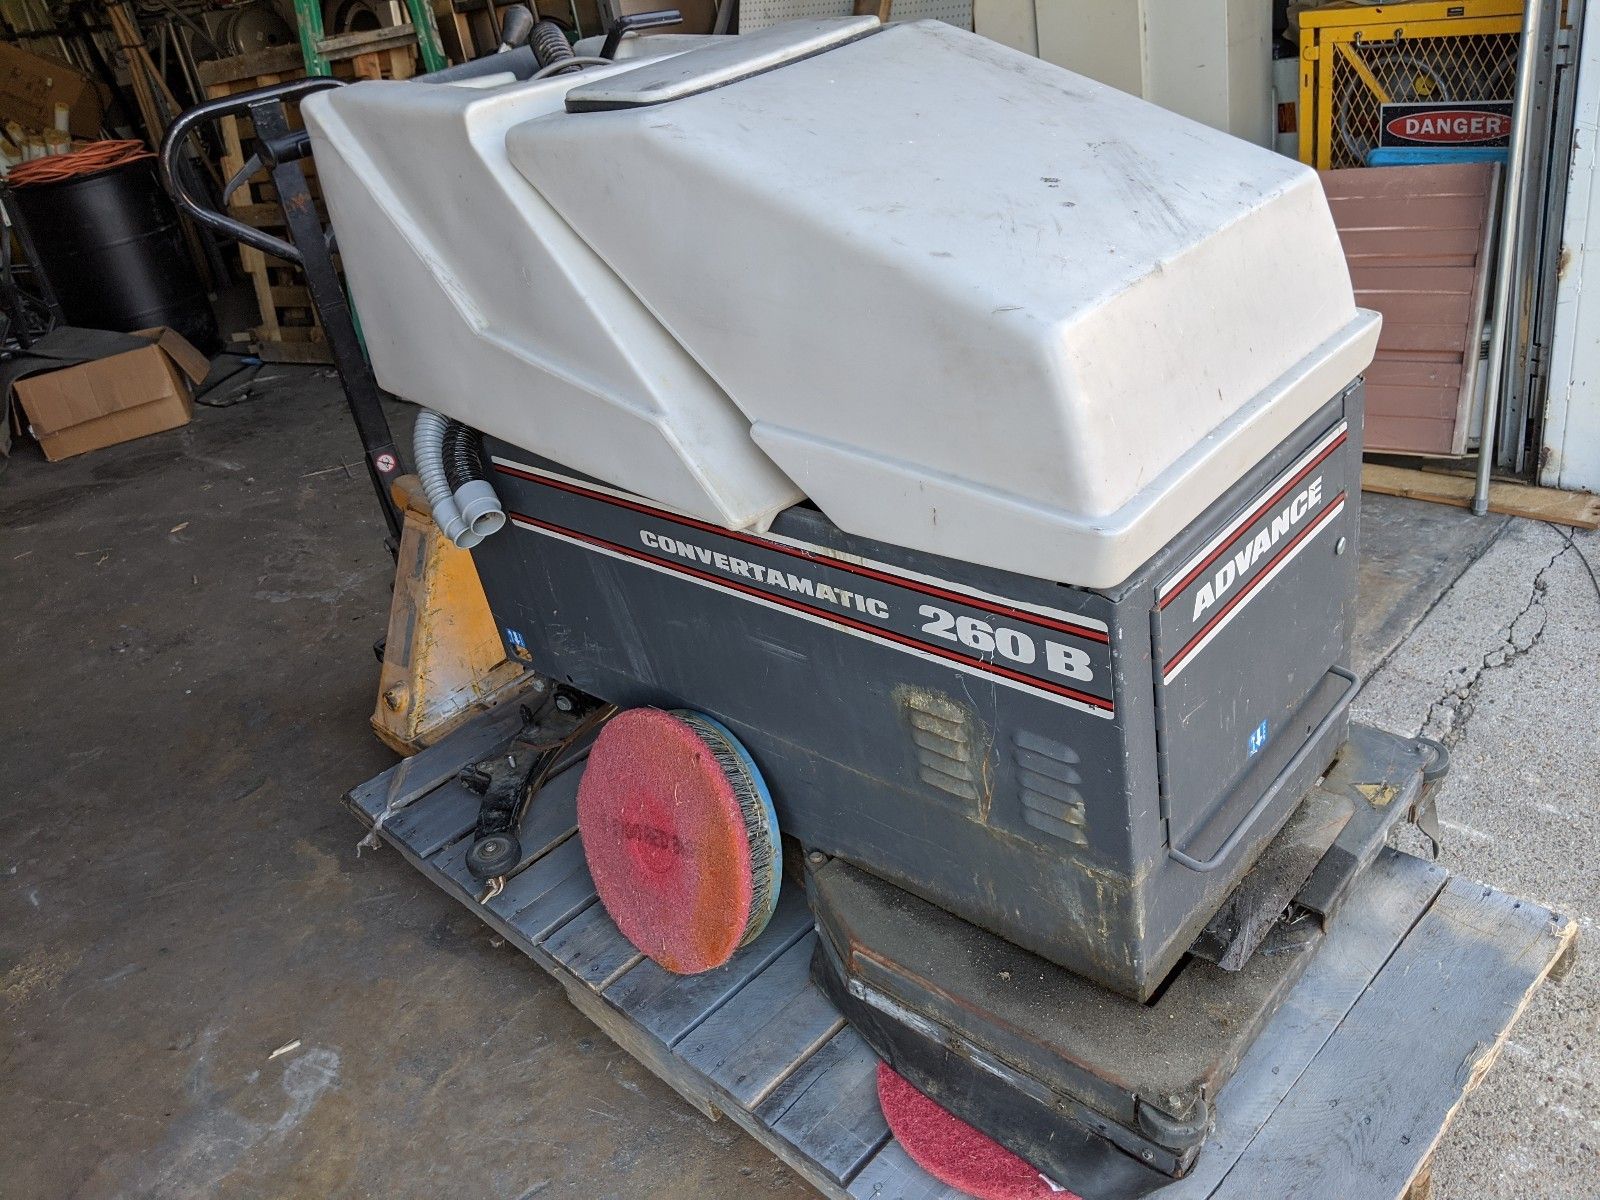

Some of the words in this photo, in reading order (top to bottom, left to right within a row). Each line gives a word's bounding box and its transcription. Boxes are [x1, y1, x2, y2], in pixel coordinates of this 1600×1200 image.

[1405, 117, 1501, 135] DANGER
[639, 529, 889, 619] CONVERTAMATIC
[919, 604, 1036, 664] 260
[1045, 640, 1094, 682] B
[1192, 475, 1323, 622] ADVANCE
